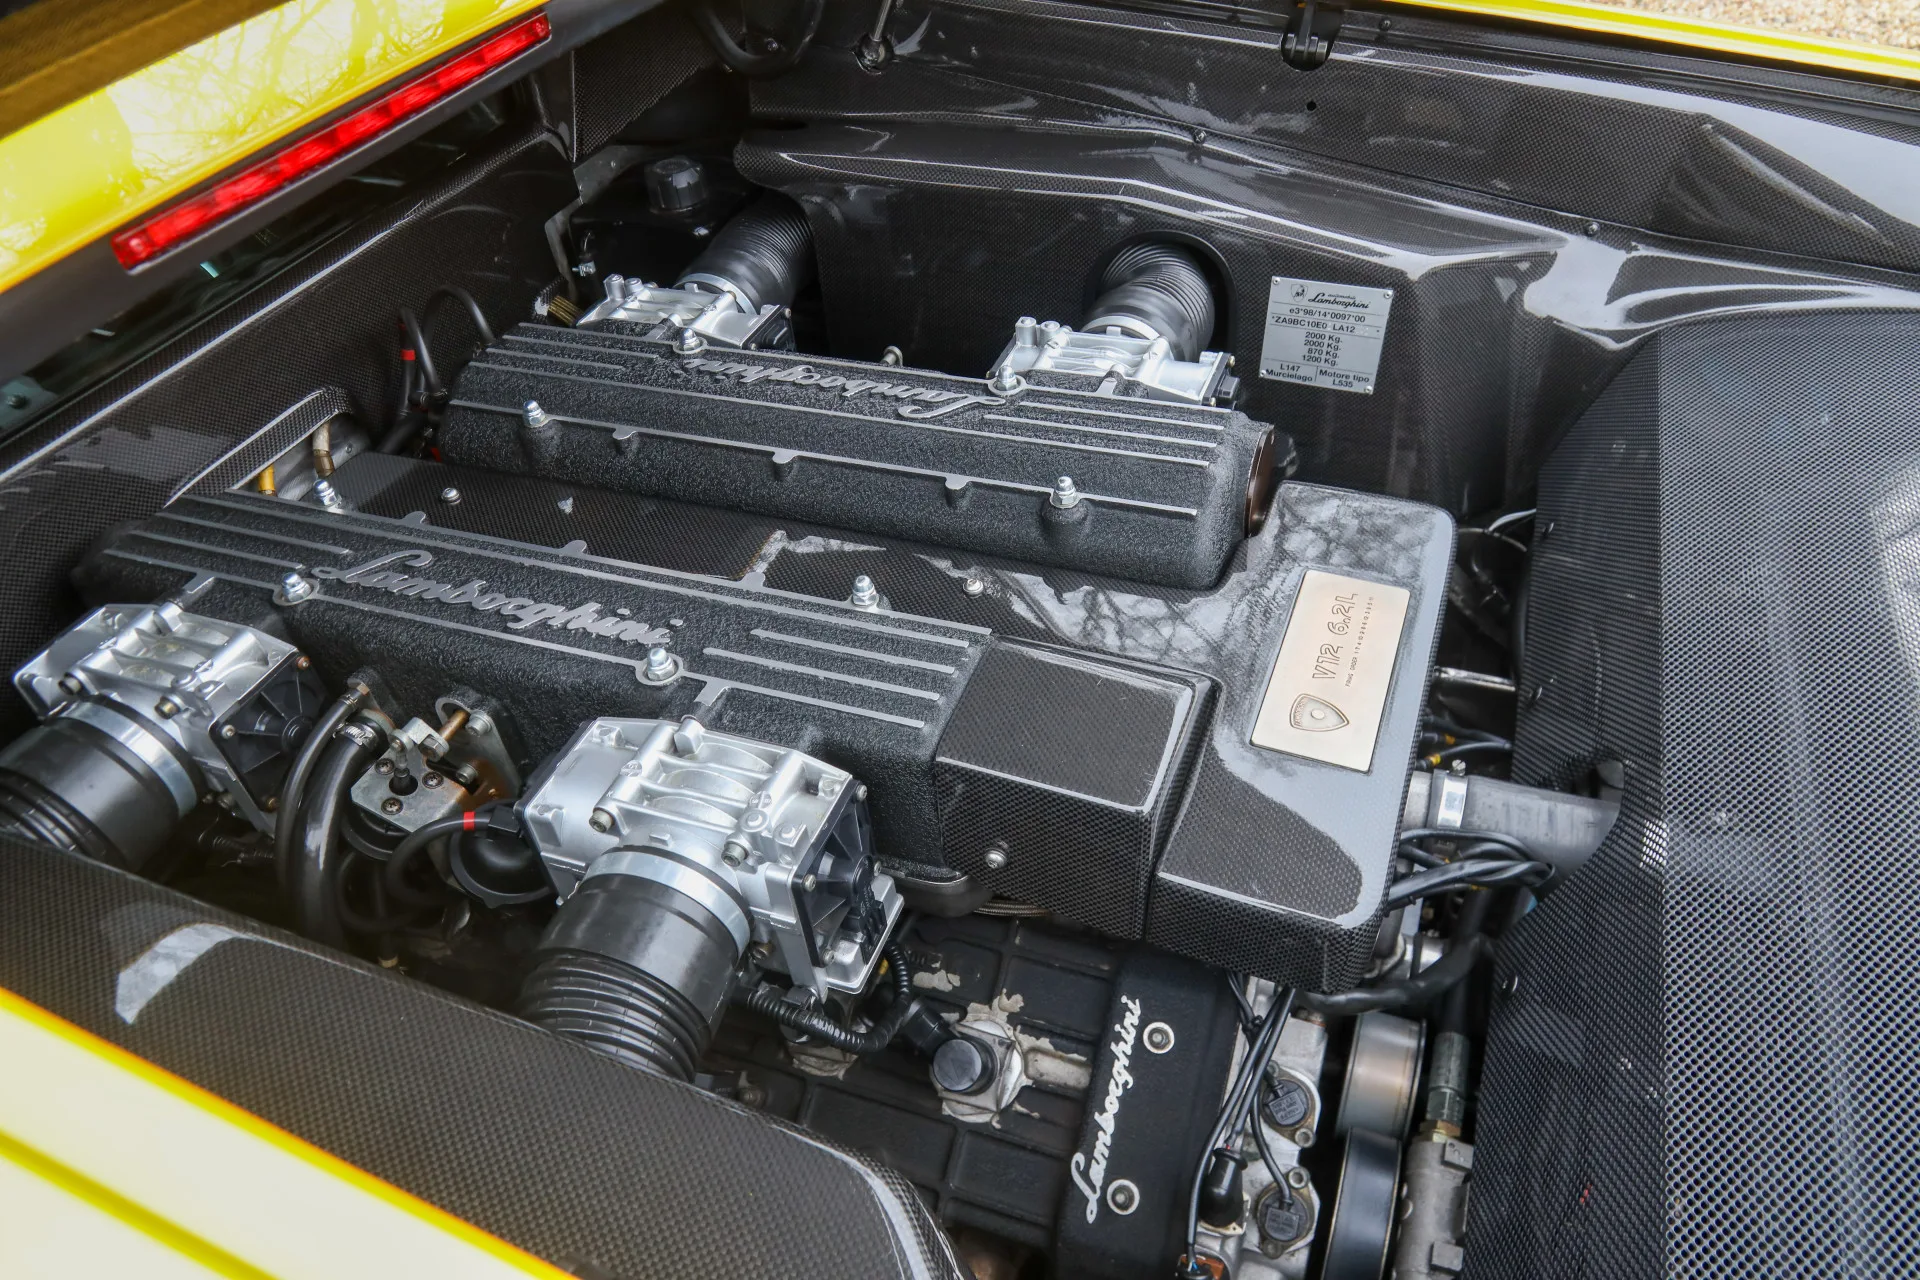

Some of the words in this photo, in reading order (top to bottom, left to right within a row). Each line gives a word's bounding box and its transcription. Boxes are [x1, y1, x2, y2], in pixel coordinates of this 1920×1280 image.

[1307, 292, 1370, 309] Lamborghini
[1305, 331, 1326, 340] 2000
[1328, 334, 1343, 343] Kg.
[1304, 339, 1325, 348] 2000
[1326, 342, 1341, 351] Kg.
[1307, 347, 1323, 355] 870
[1325, 350, 1340, 359] Kg.
[1280, 363, 1301, 372] L147
[1302, 354, 1322, 363] 1200
[1323, 358, 1338, 367] Kg.
[1266, 368, 1313, 382] Murcielago
[1319, 369, 1350, 380] Motore
[1352, 372, 1370, 383] tipo
[673, 358, 1007, 419] Lamborghini
[1332, 379, 1353, 388] L535
[311, 549, 684, 645] Lamborghini
[1312, 643, 1344, 679] V12
[1071, 995, 1141, 1224] Lamborghini
